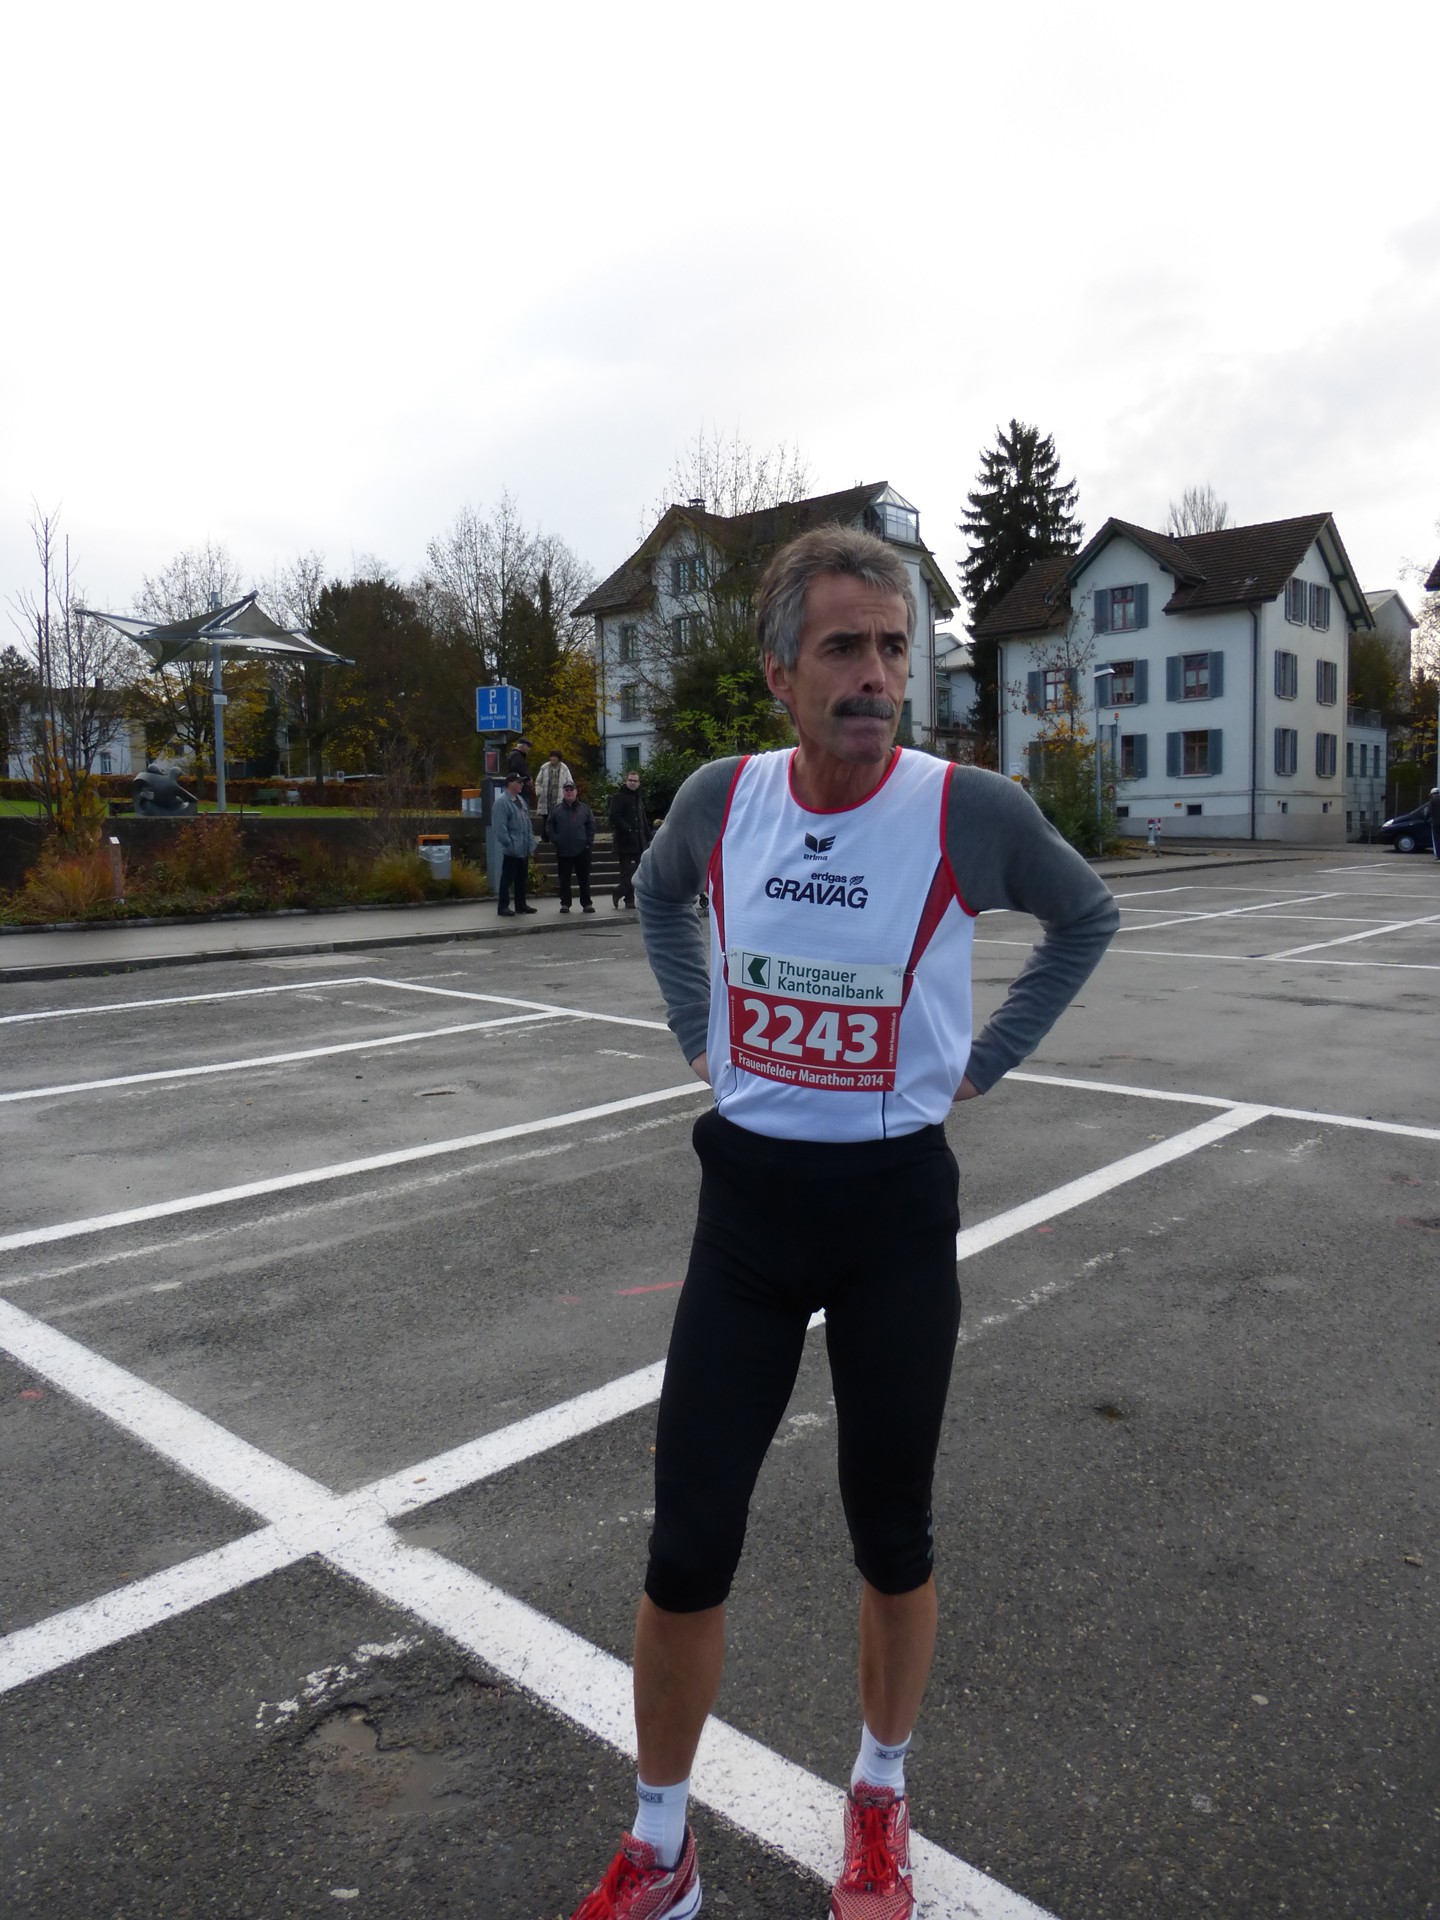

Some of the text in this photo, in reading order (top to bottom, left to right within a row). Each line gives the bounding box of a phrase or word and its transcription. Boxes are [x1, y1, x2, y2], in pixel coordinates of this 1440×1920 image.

[489, 689, 496, 703] P
[803, 853, 828, 861] erima
[811, 872, 847, 884] erdgas
[765, 877, 869, 909] GRAVAG
[777, 960, 857, 983] Thurgauer
[777, 976, 884, 1000] Kantonalbank
[742, 998, 879, 1064] 2243
[738, 1052, 884, 1087] Frauenfelder Marathon 2014
